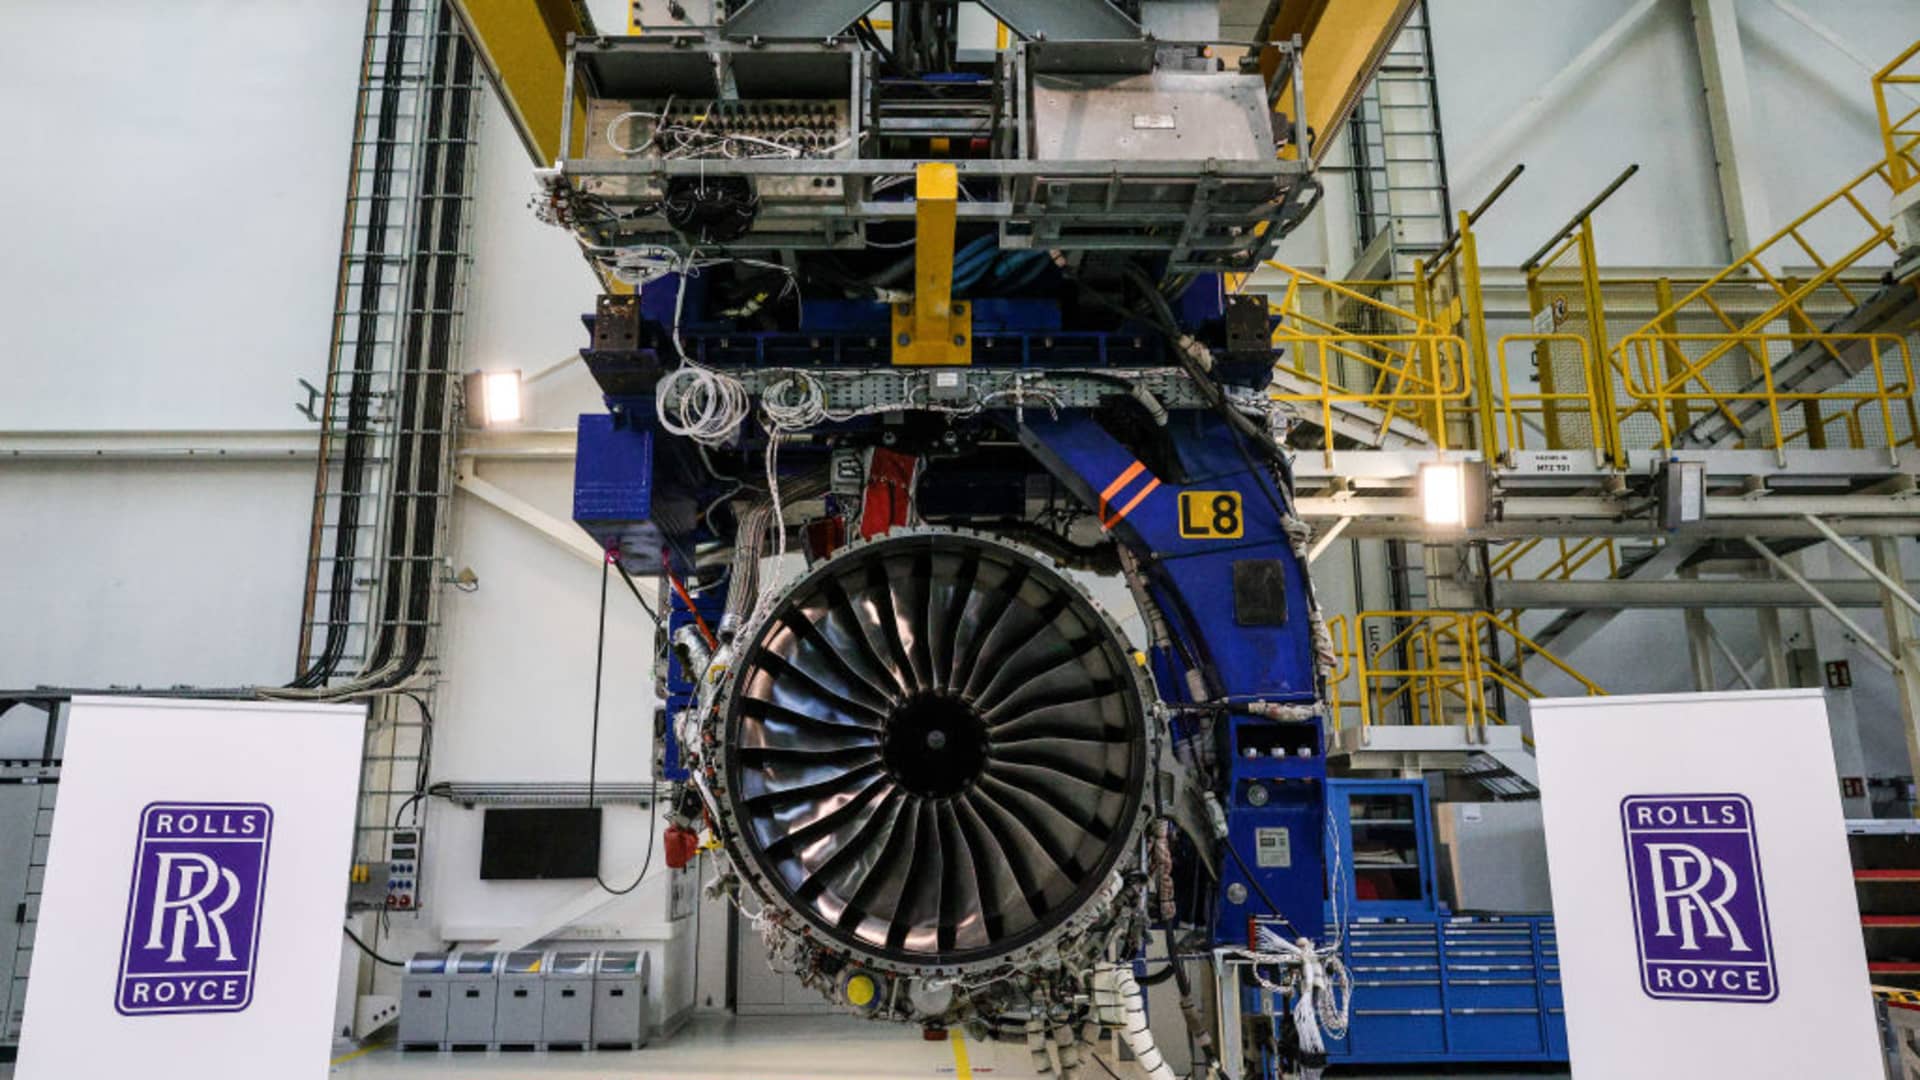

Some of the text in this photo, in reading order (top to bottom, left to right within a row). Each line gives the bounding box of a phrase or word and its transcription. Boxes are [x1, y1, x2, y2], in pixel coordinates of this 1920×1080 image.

[1181, 494, 1238, 535] L8
[156, 813, 256, 834] ROLLS
[1636, 804, 1736, 825] ROLLS
[1656, 967, 1763, 991] ROYCE
[132, 980, 239, 1003] ROYCE
